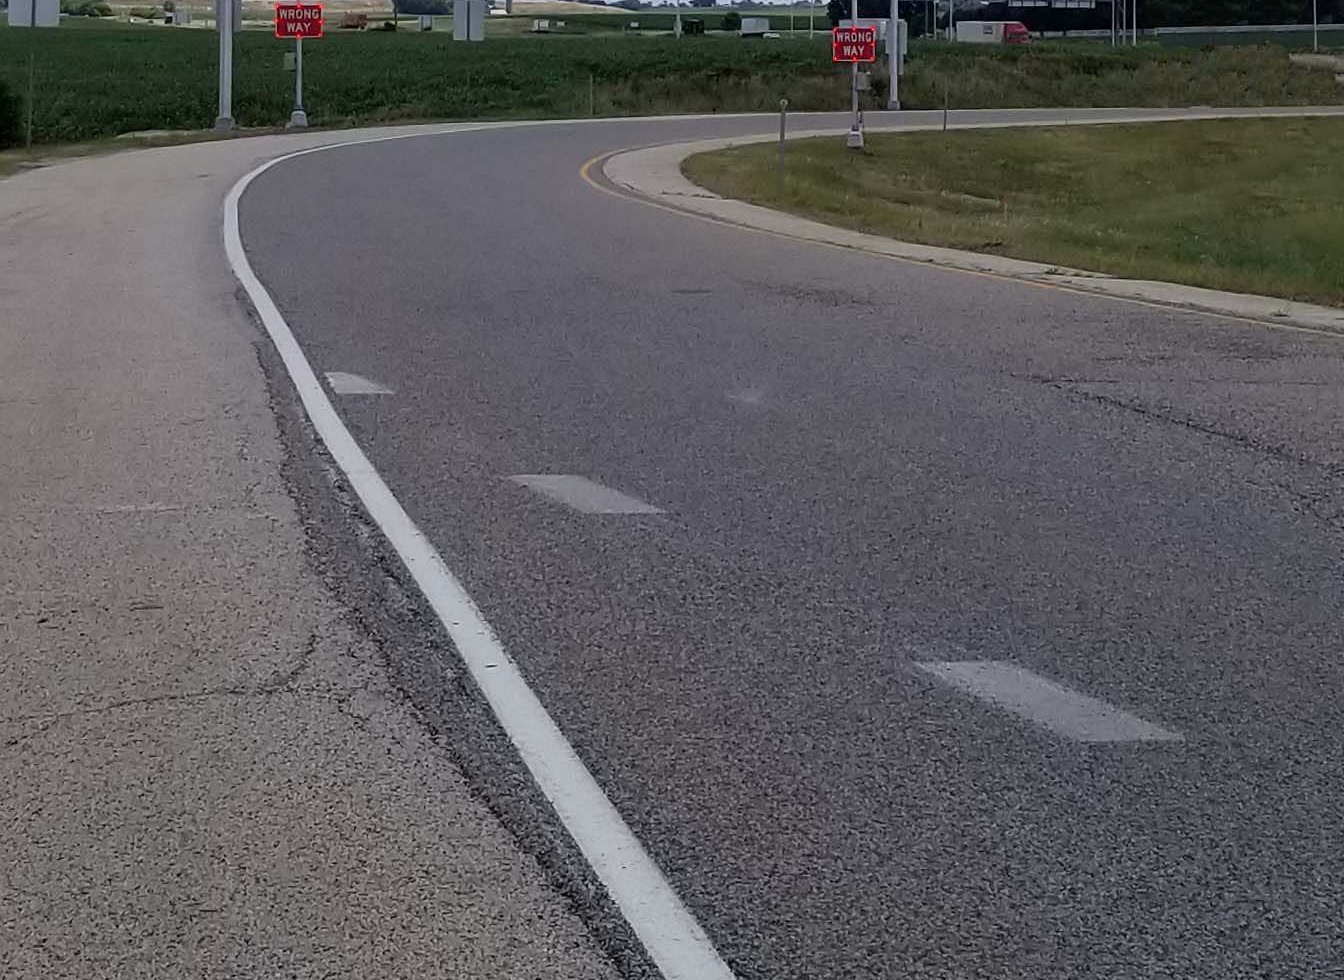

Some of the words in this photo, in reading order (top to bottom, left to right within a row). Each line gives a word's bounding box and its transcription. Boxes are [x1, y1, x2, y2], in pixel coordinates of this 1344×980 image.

[279, 9, 319, 19] WRONG
[286, 22, 312, 32] WAY
[836, 32, 872, 42] WRONG
[843, 45, 865, 56] WAY
